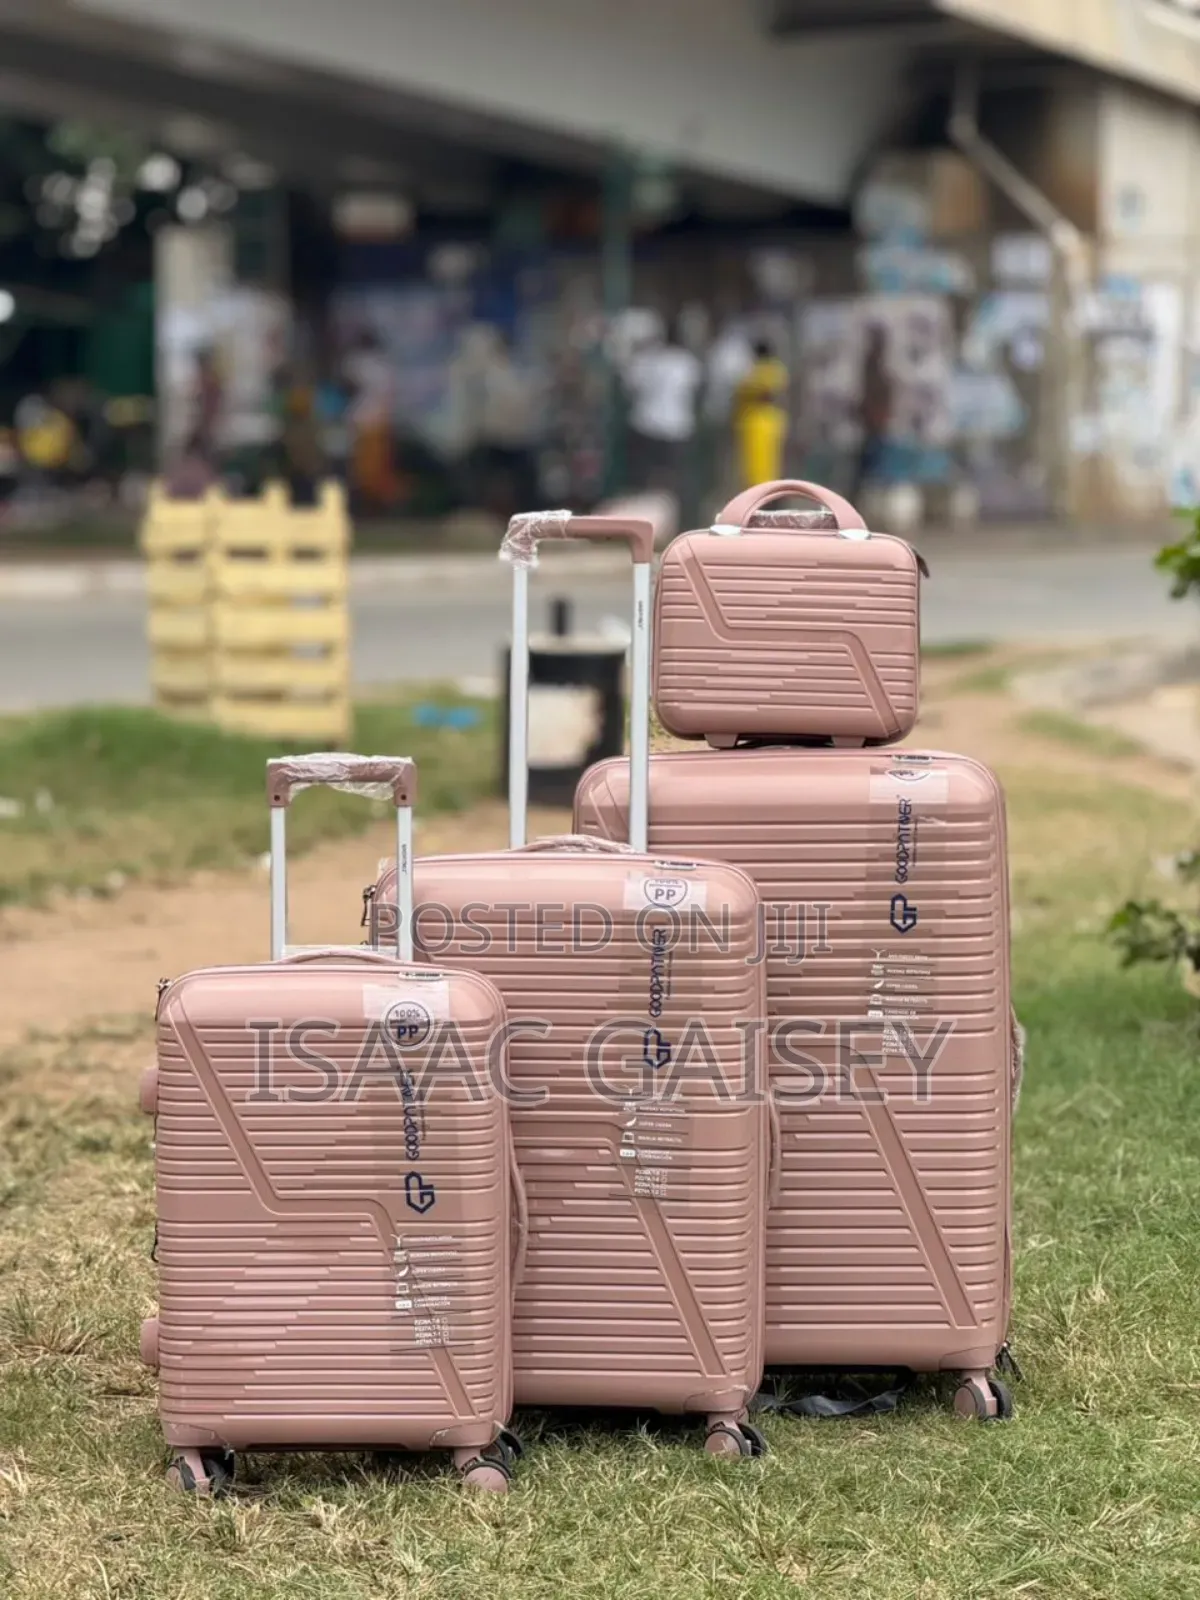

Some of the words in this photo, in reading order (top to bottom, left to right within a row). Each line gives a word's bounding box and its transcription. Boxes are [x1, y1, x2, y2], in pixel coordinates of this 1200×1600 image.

[654, 888, 677, 901] PP
[394, 1009, 421, 1018] 100%
[396, 1024, 420, 1039] PP
